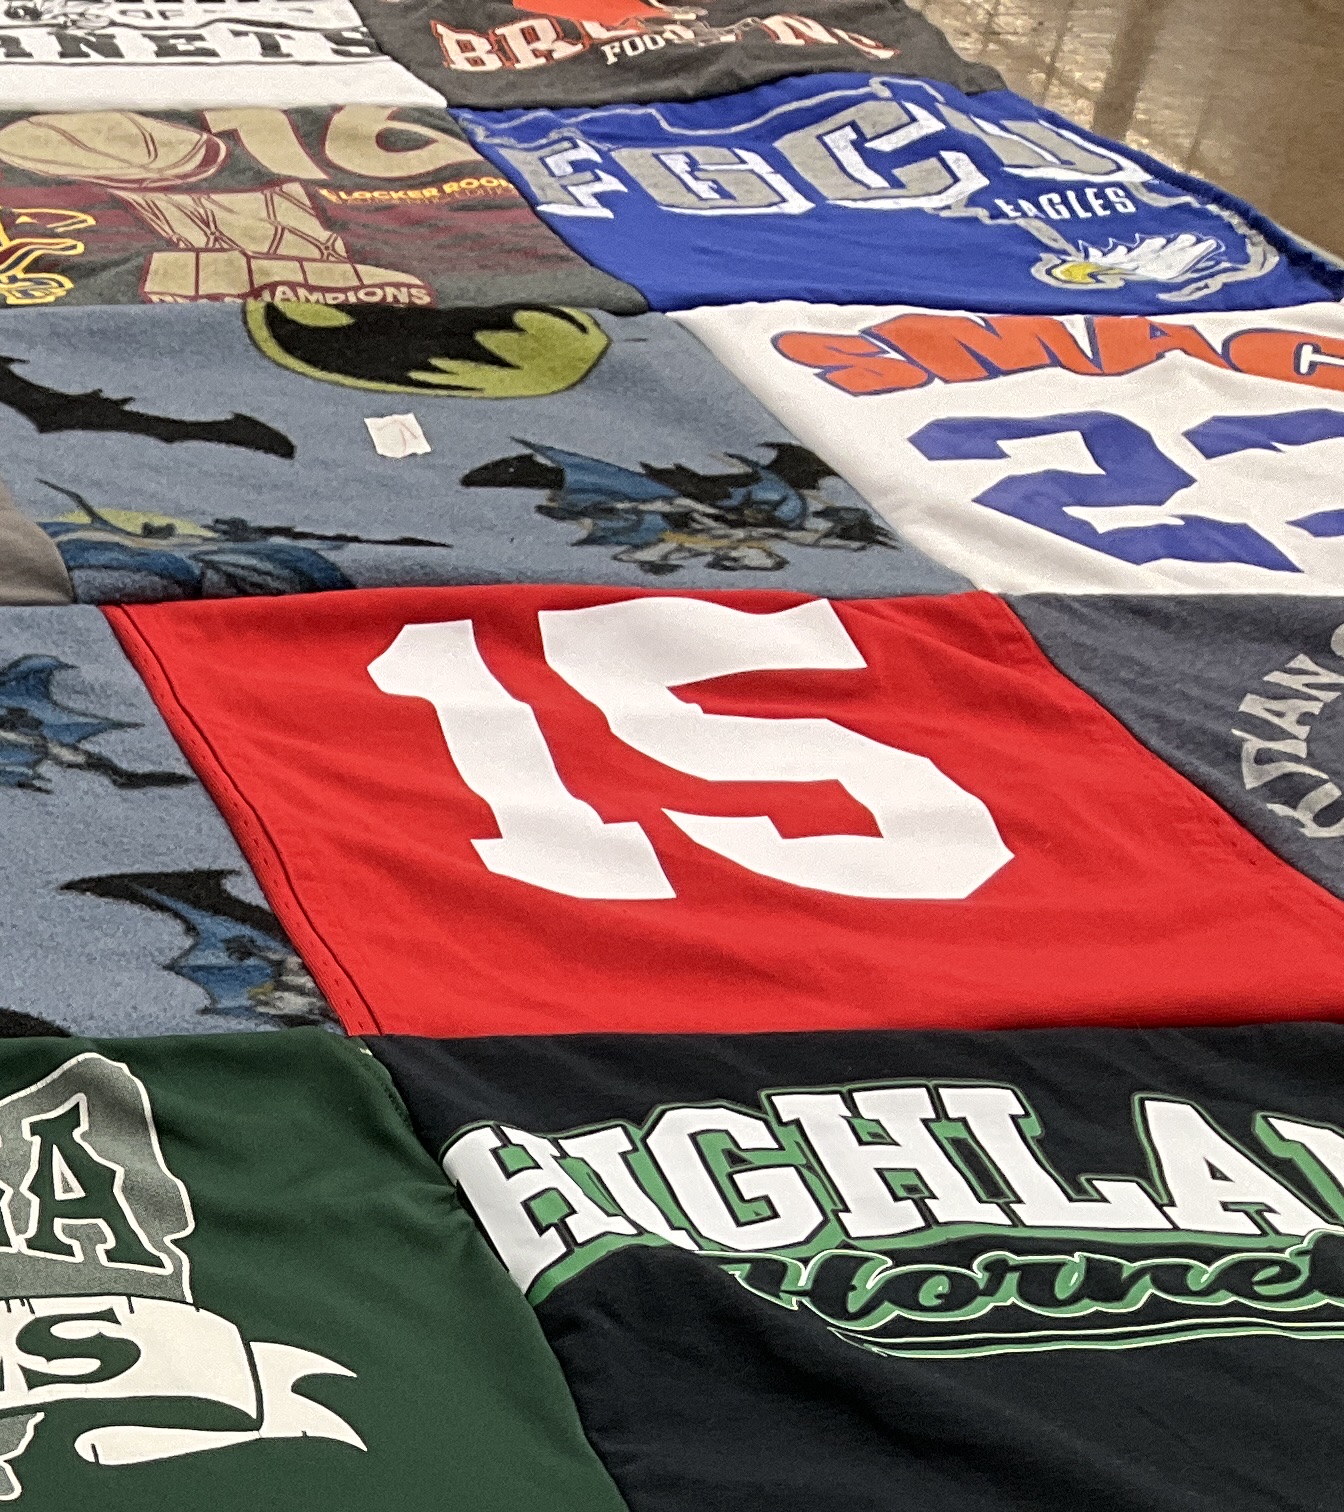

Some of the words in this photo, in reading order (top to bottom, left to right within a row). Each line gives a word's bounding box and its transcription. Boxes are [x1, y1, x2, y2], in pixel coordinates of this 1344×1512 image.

[497, 94, 1157, 219] FGCU
[994, 187, 1137, 220] EAGLES
[223, 285, 431, 305] AMPIONS
[366, 596, 1016, 900] 15
